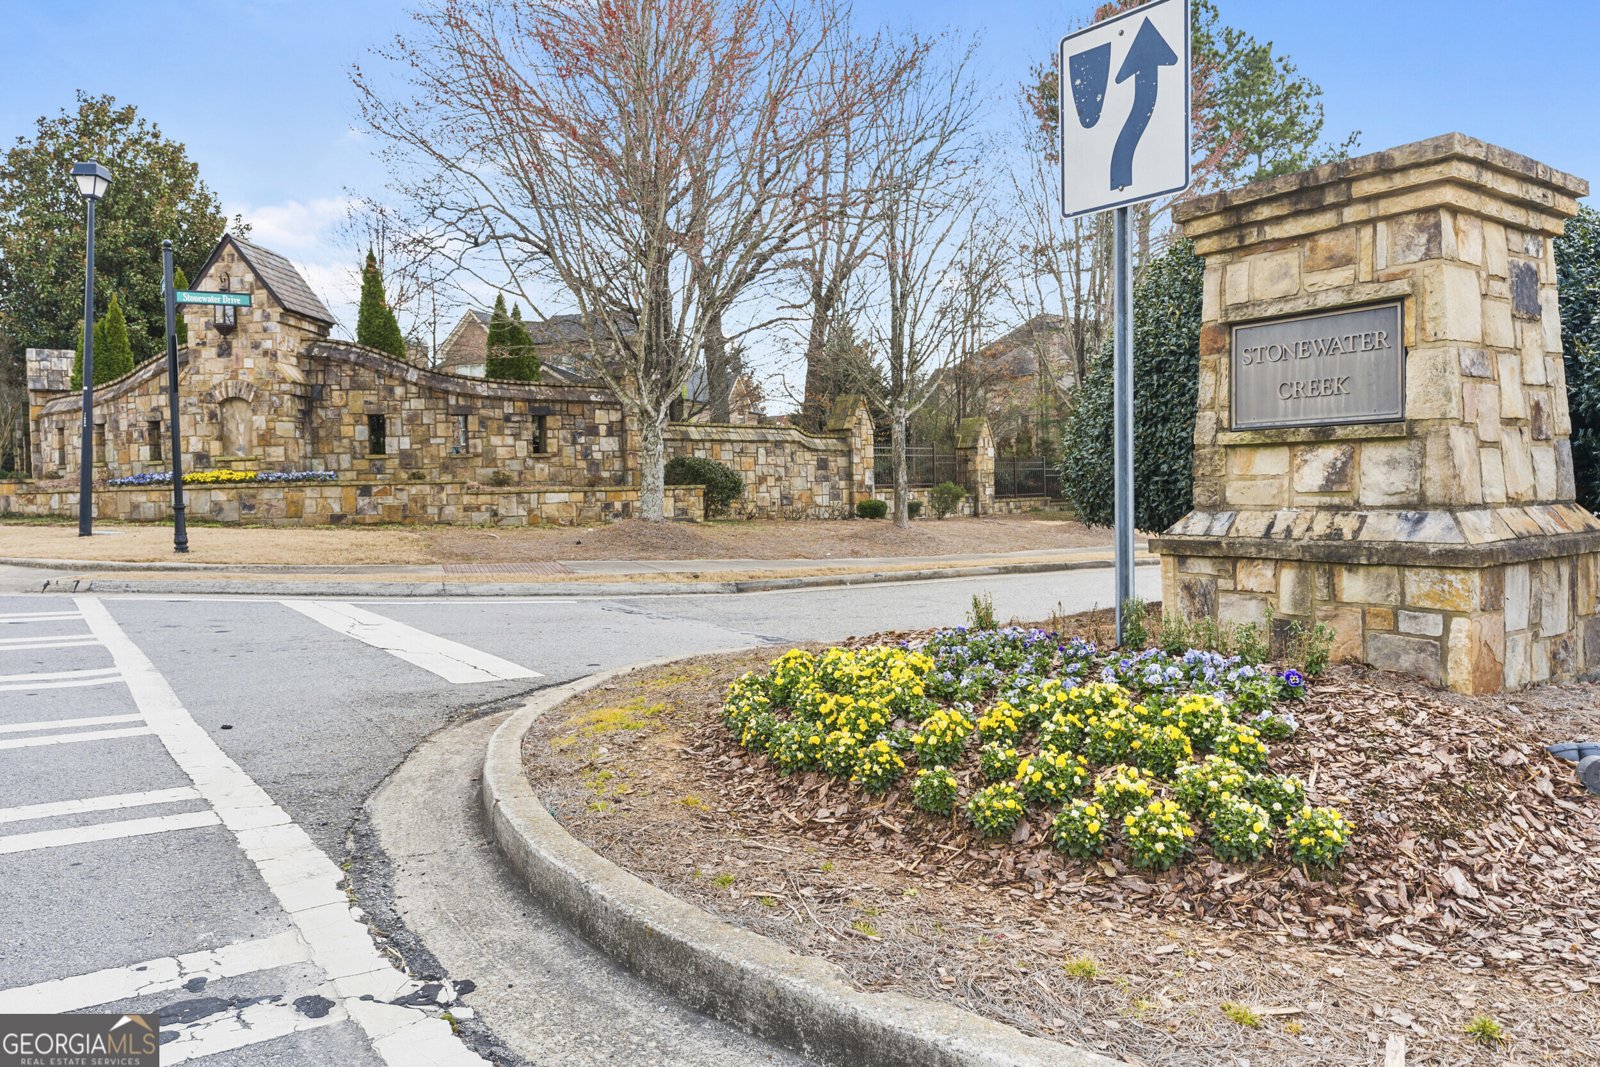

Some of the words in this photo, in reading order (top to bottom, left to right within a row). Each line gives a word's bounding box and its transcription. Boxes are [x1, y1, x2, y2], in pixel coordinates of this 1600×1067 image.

[182, 292, 220, 303] Stonewater
[222, 294, 241, 305] Drive
[1242, 330, 1392, 366] STONEWATER
[1277, 375, 1351, 401] CREEK
